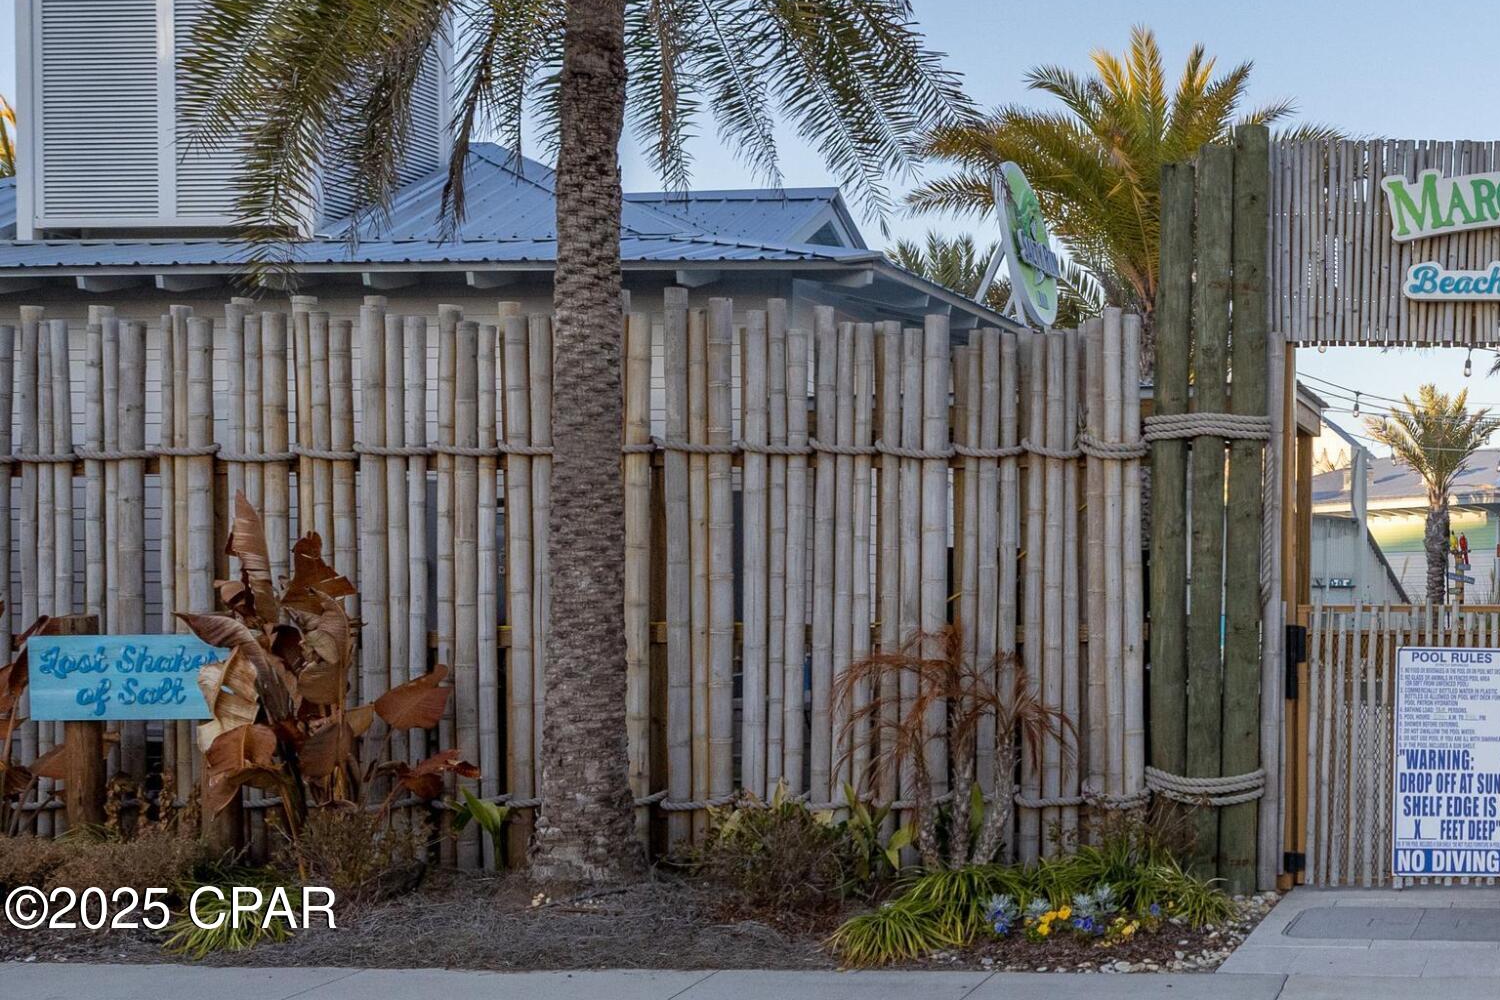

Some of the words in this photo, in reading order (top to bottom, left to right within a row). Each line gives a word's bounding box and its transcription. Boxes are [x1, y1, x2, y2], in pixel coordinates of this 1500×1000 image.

[40, 645, 109, 680] Lost
[1411, 651, 1447, 663] POOL
[1450, 652, 1493, 664] RULES
[76, 677, 112, 716] of
[118, 677, 187, 706] Salt
[1399, 749, 1475, 771] "WARNING:
[1399, 772, 1433, 794] DROP
[1436, 772, 1457, 794] OFF
[1459, 773, 1474, 794] AT
[1403, 795, 1442, 817] SHELF
[1446, 796, 1479, 817] EDGE
[1483, 796, 1497, 818] IS
[1440, 819, 1465, 840] FEET
[1397, 849, 1426, 872] NO
[1432, 850, 1500, 873] DIVING
